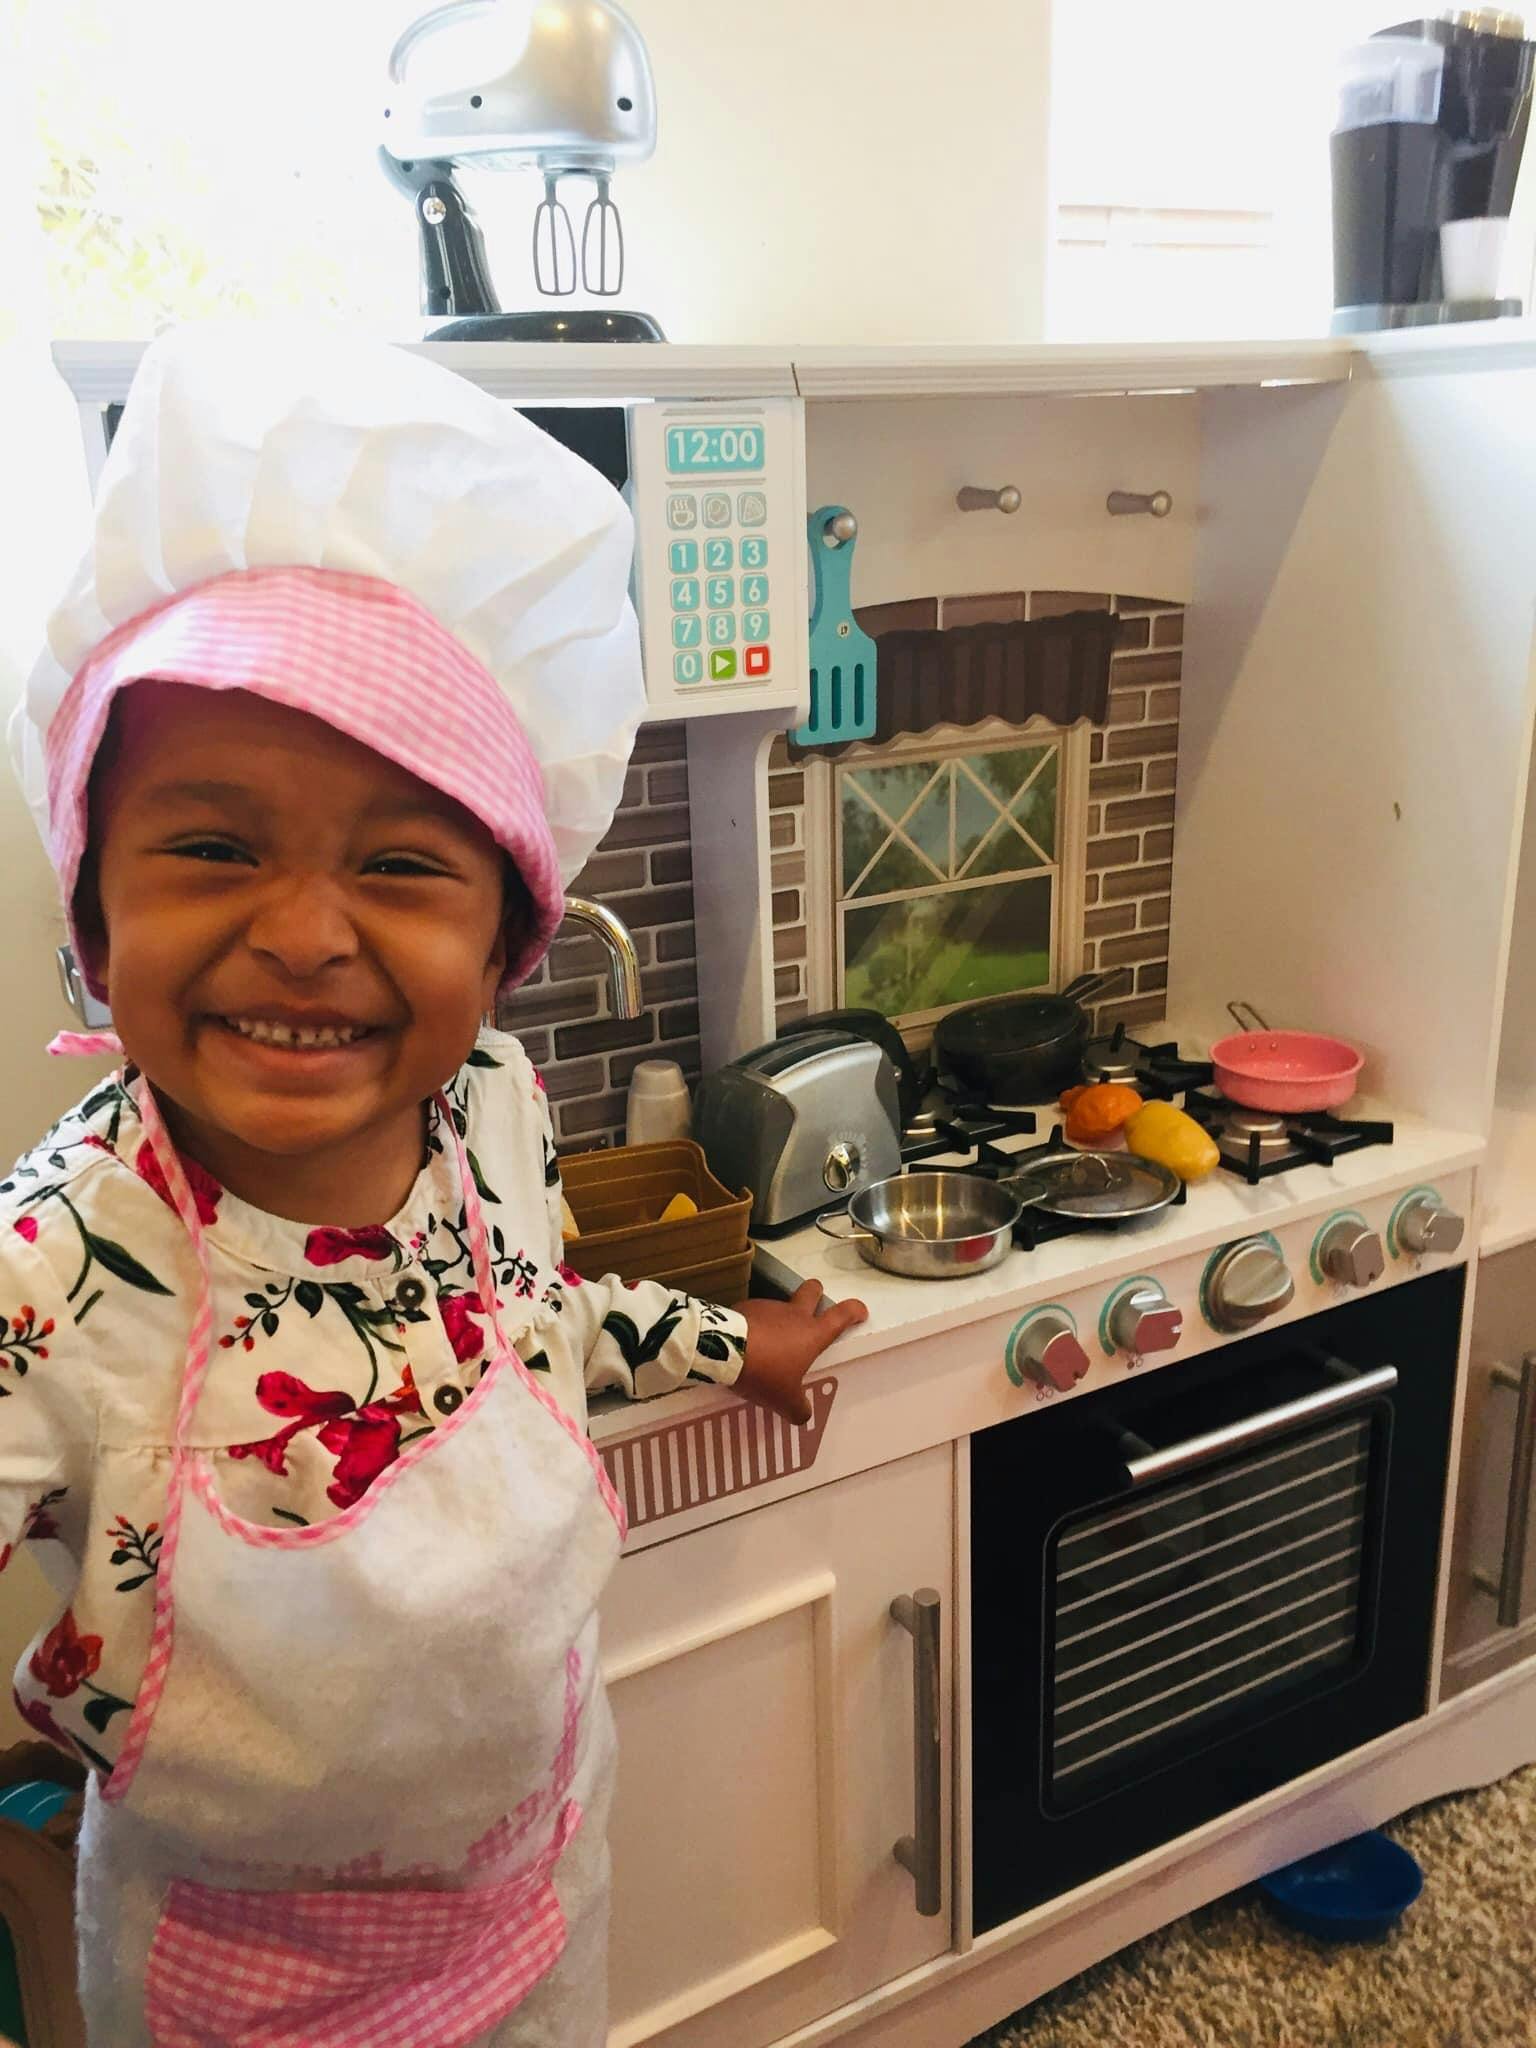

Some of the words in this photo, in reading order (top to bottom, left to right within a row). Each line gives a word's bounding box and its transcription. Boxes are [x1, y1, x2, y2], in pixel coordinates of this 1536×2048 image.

[672, 429, 758, 463] 12:00
[678, 544, 687, 568] 1
[712, 542, 726, 566] 2
[747, 540, 761, 564] 3
[677, 582, 692, 606] 4
[714, 580, 727, 604] 5
[748, 579, 761, 602] 6
[680, 618, 694, 642] 7
[715, 616, 728, 639] 8
[750, 613, 763, 637] 9
[682, 654, 696, 679] 0
